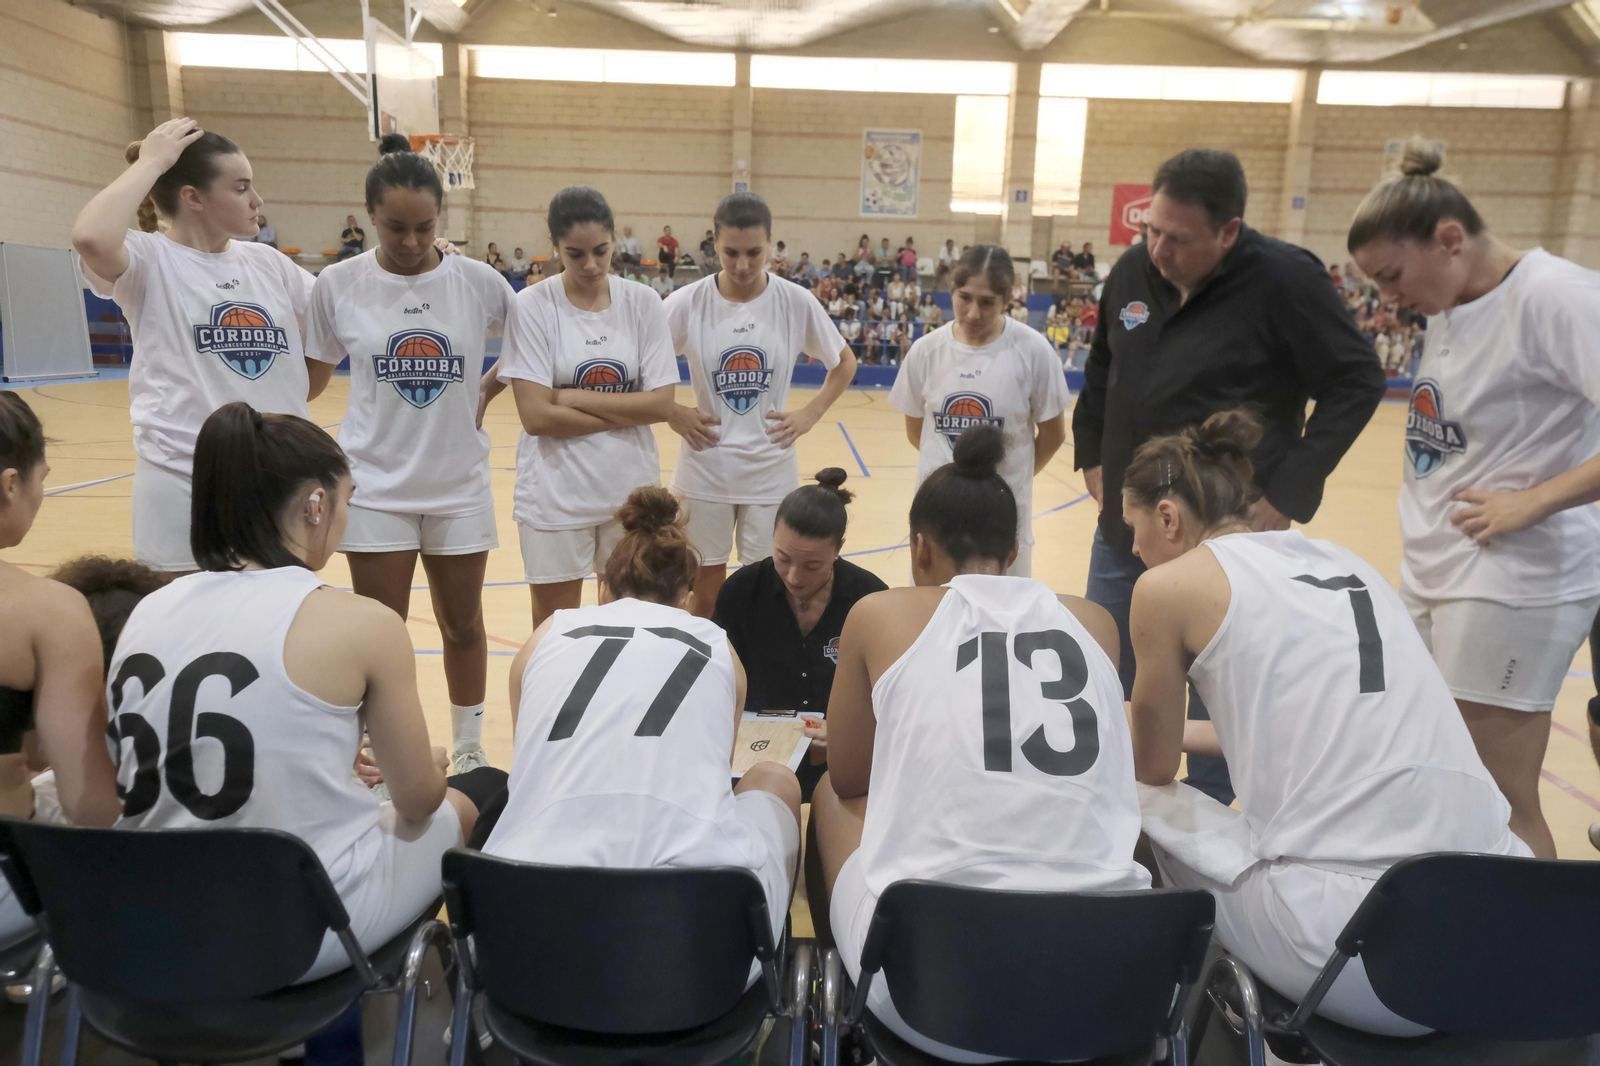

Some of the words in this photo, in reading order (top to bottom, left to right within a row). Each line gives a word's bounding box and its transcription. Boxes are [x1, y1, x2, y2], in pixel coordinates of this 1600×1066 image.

[199, 326, 287, 347] CÓRDOBA
[252, 342, 280, 350] FEMENINO
[377, 356, 462, 375] CÓRDOBA
[387, 371, 423, 379] BALONCESTO
[425, 371, 453, 379] FEMENINO
[1289, 573, 1386, 694] 7
[547, 624, 712, 742] 77
[956, 628, 1100, 777] 13
[105, 651, 261, 822] 66
